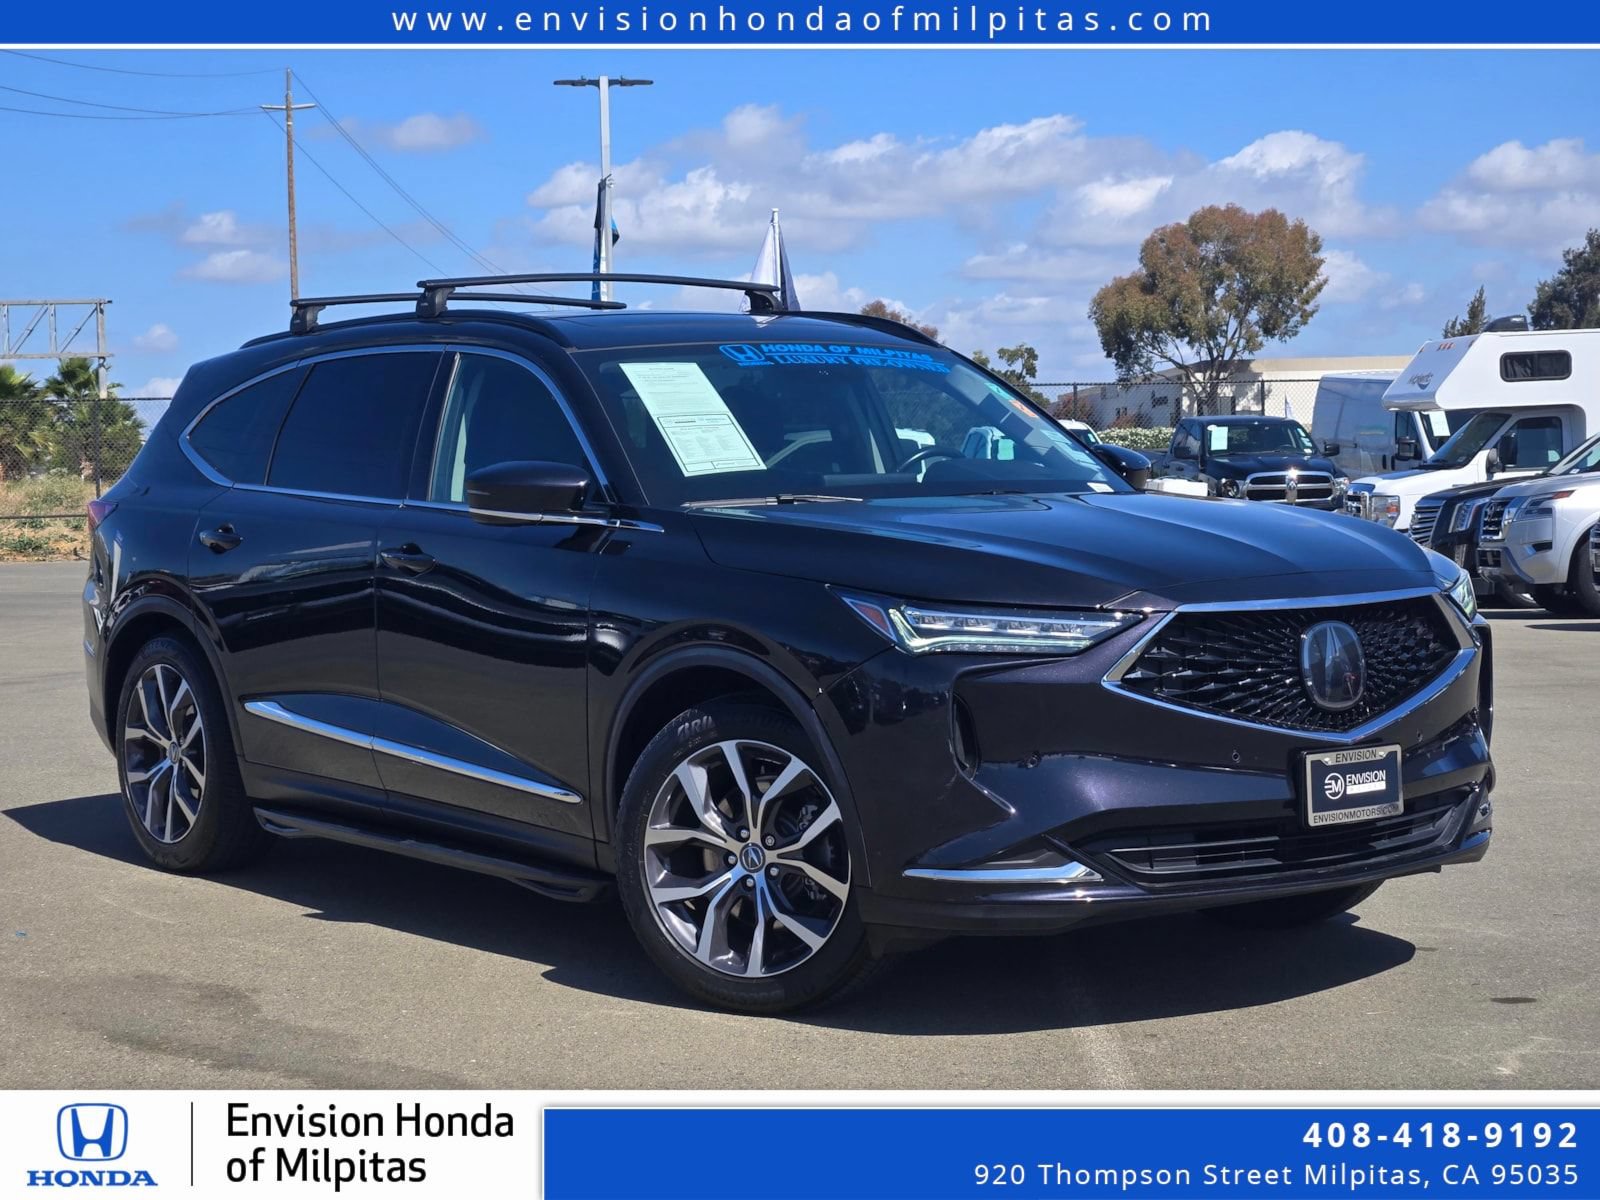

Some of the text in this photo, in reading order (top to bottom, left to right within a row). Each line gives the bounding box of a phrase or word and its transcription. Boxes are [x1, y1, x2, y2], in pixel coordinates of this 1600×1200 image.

[760, 343, 828, 354] HONDA
[828, 345, 852, 354] OF
[774, 354, 849, 365] LUXURY
[1335, 749, 1377, 763] ENVISION
[1346, 770, 1387, 786] ENVISION
